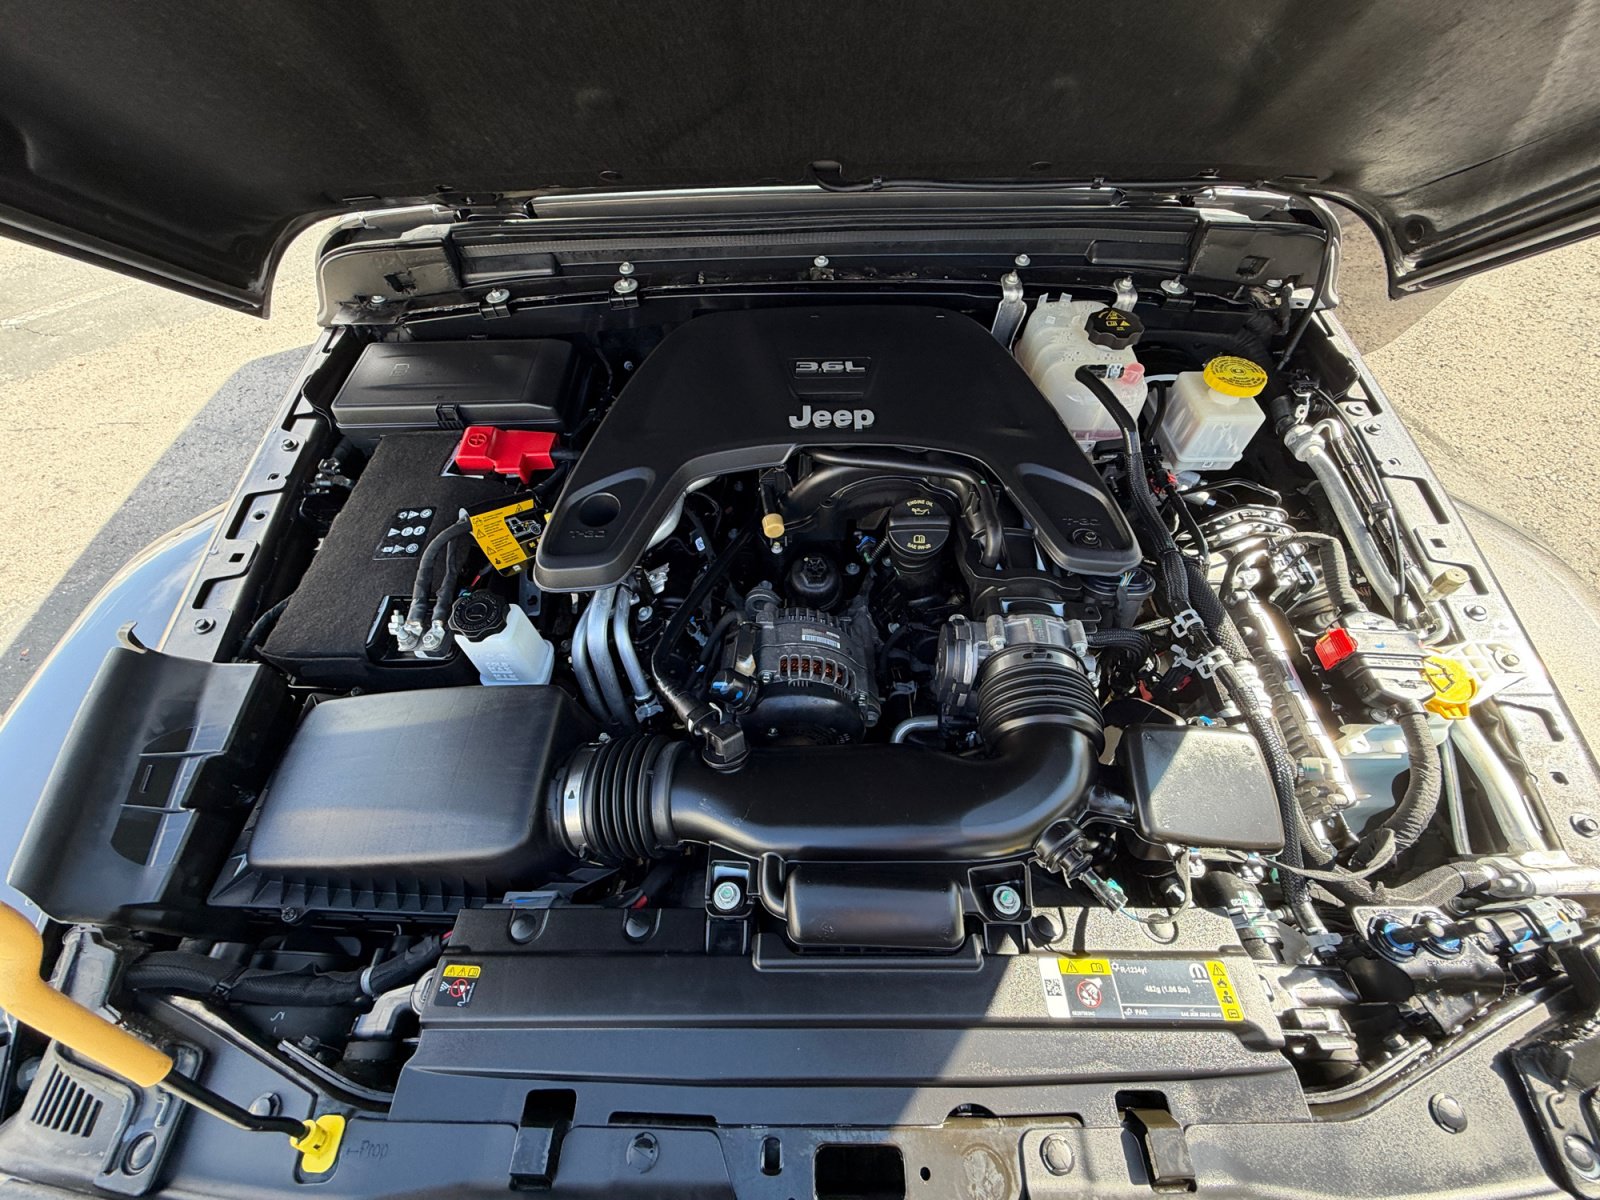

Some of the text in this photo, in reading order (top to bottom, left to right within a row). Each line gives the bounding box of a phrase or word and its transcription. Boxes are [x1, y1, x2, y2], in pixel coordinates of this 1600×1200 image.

[795, 361, 866, 374] 3.6L
[788, 405, 875, 431] Jeep
[906, 499, 925, 507] ENGINE
[906, 542, 917, 550] SAE
